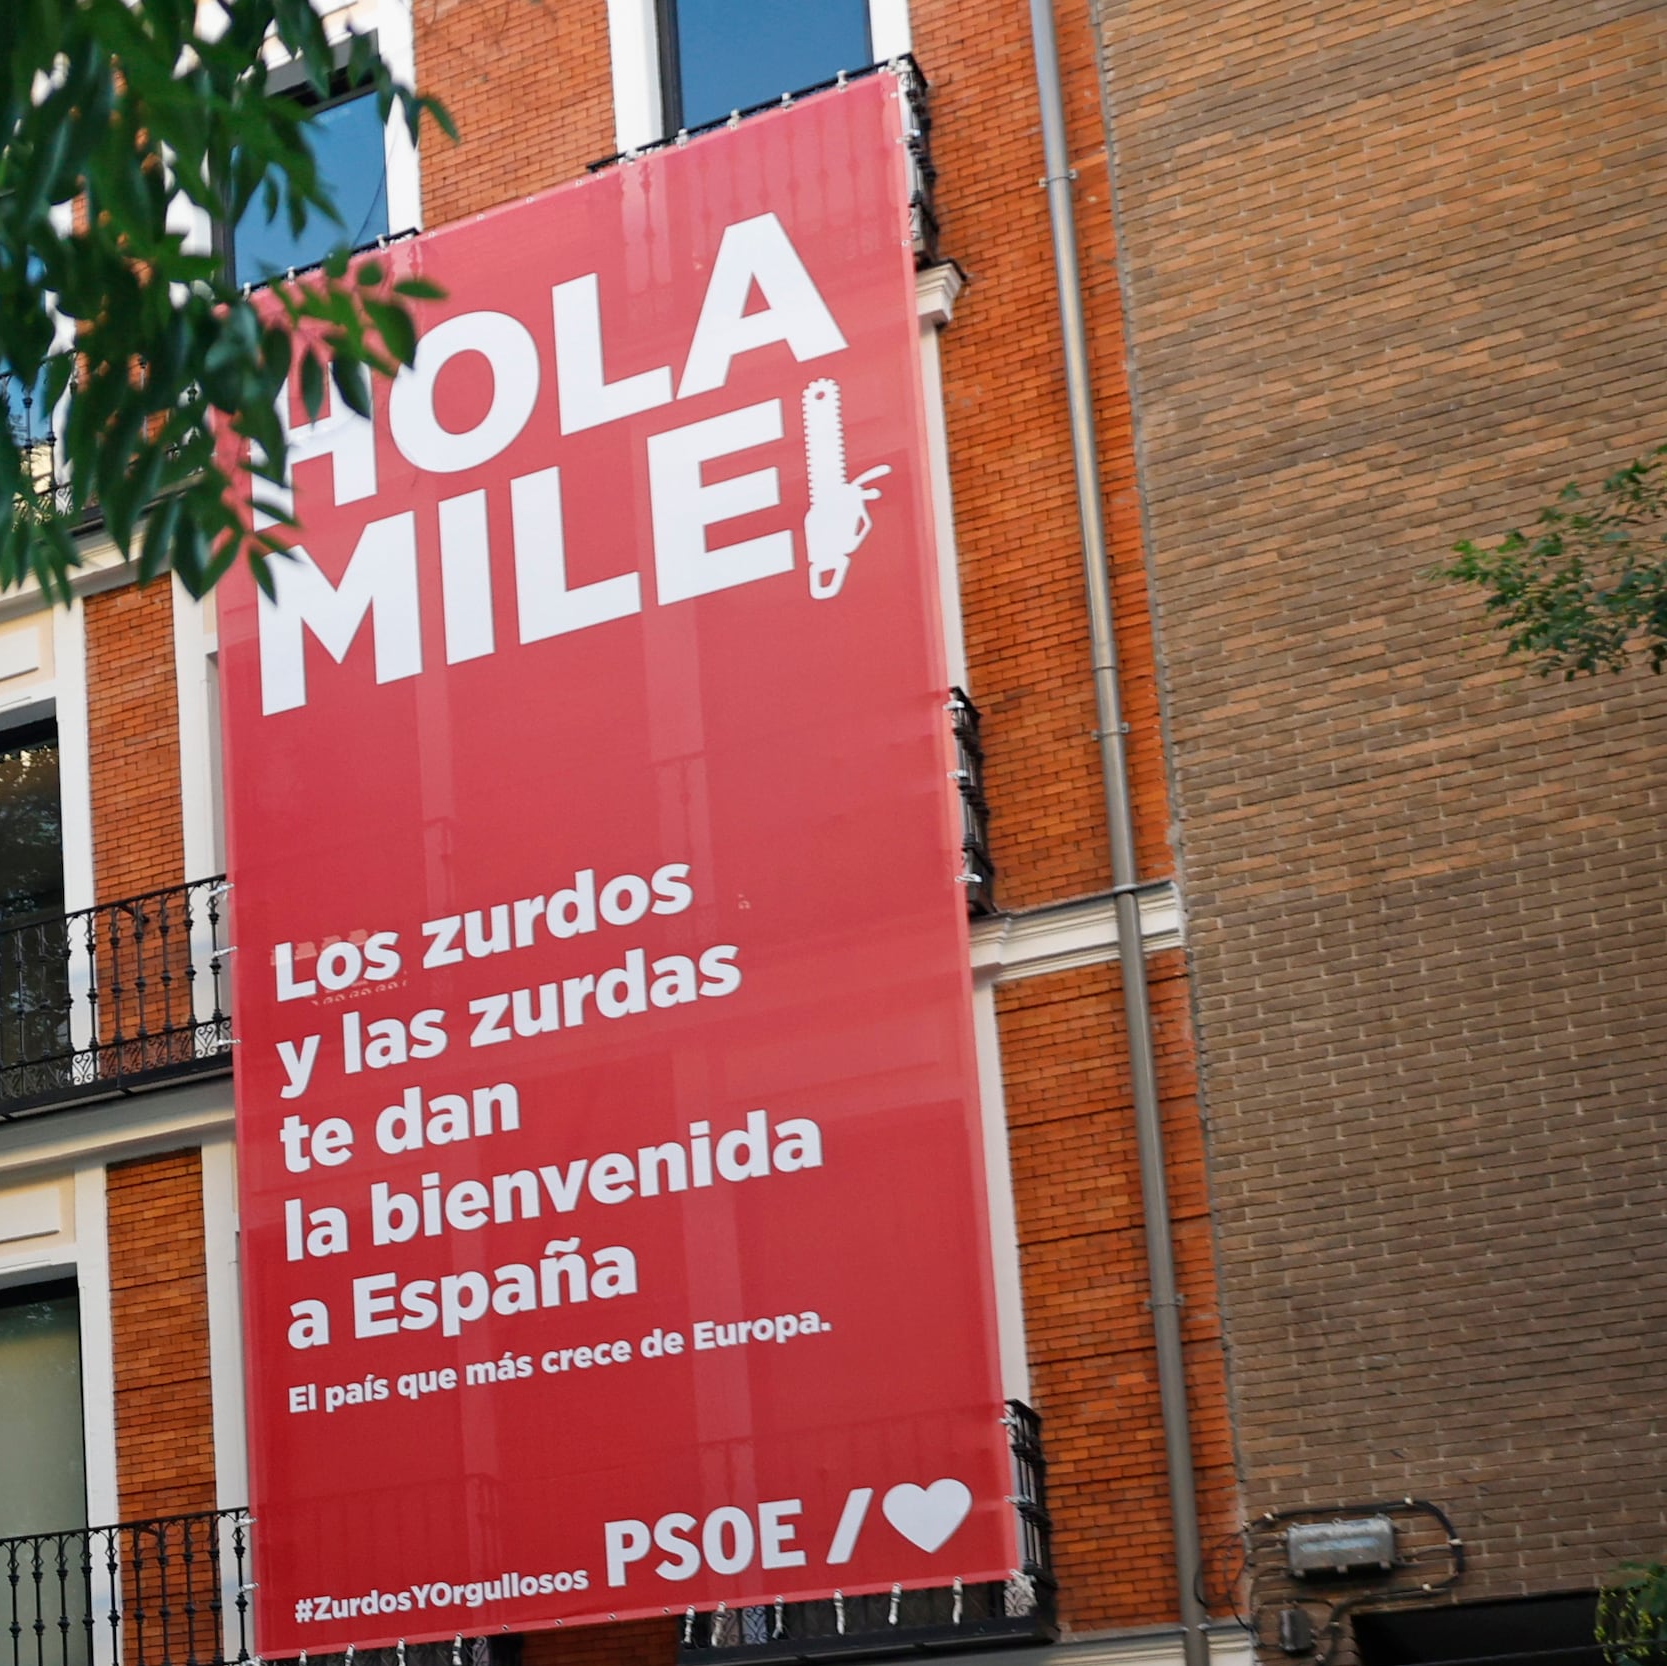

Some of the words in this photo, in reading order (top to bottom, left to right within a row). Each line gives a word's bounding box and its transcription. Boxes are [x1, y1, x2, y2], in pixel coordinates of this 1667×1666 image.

[250, 212, 849, 533] HOLA
[274, 931, 402, 1003] Los
[421, 862, 694, 970] zurdos
[275, 1034, 322, 1099] y
[342, 1008, 449, 1075] las
[469, 943, 743, 1049] zurdas
[279, 1115, 355, 1174] te
[374, 1083, 521, 1156] dan
[284, 1198, 349, 1262] la
[370, 1109, 824, 1246] bienvenida
[287, 1299, 330, 1350] a
[352, 1237, 639, 1339] España
[288, 1383, 318, 1413] El
[324, 1373, 390, 1413] país
[396, 1368, 459, 1402] que
[465, 1348, 534, 1387] más
[540, 1340, 633, 1375] crece
[639, 1327, 685, 1358] de
[692, 1310, 832, 1352] Europa.
[294, 1568, 590, 1625] #ZurdosYOrgullosos
[603, 1498, 807, 1589] PSOE
